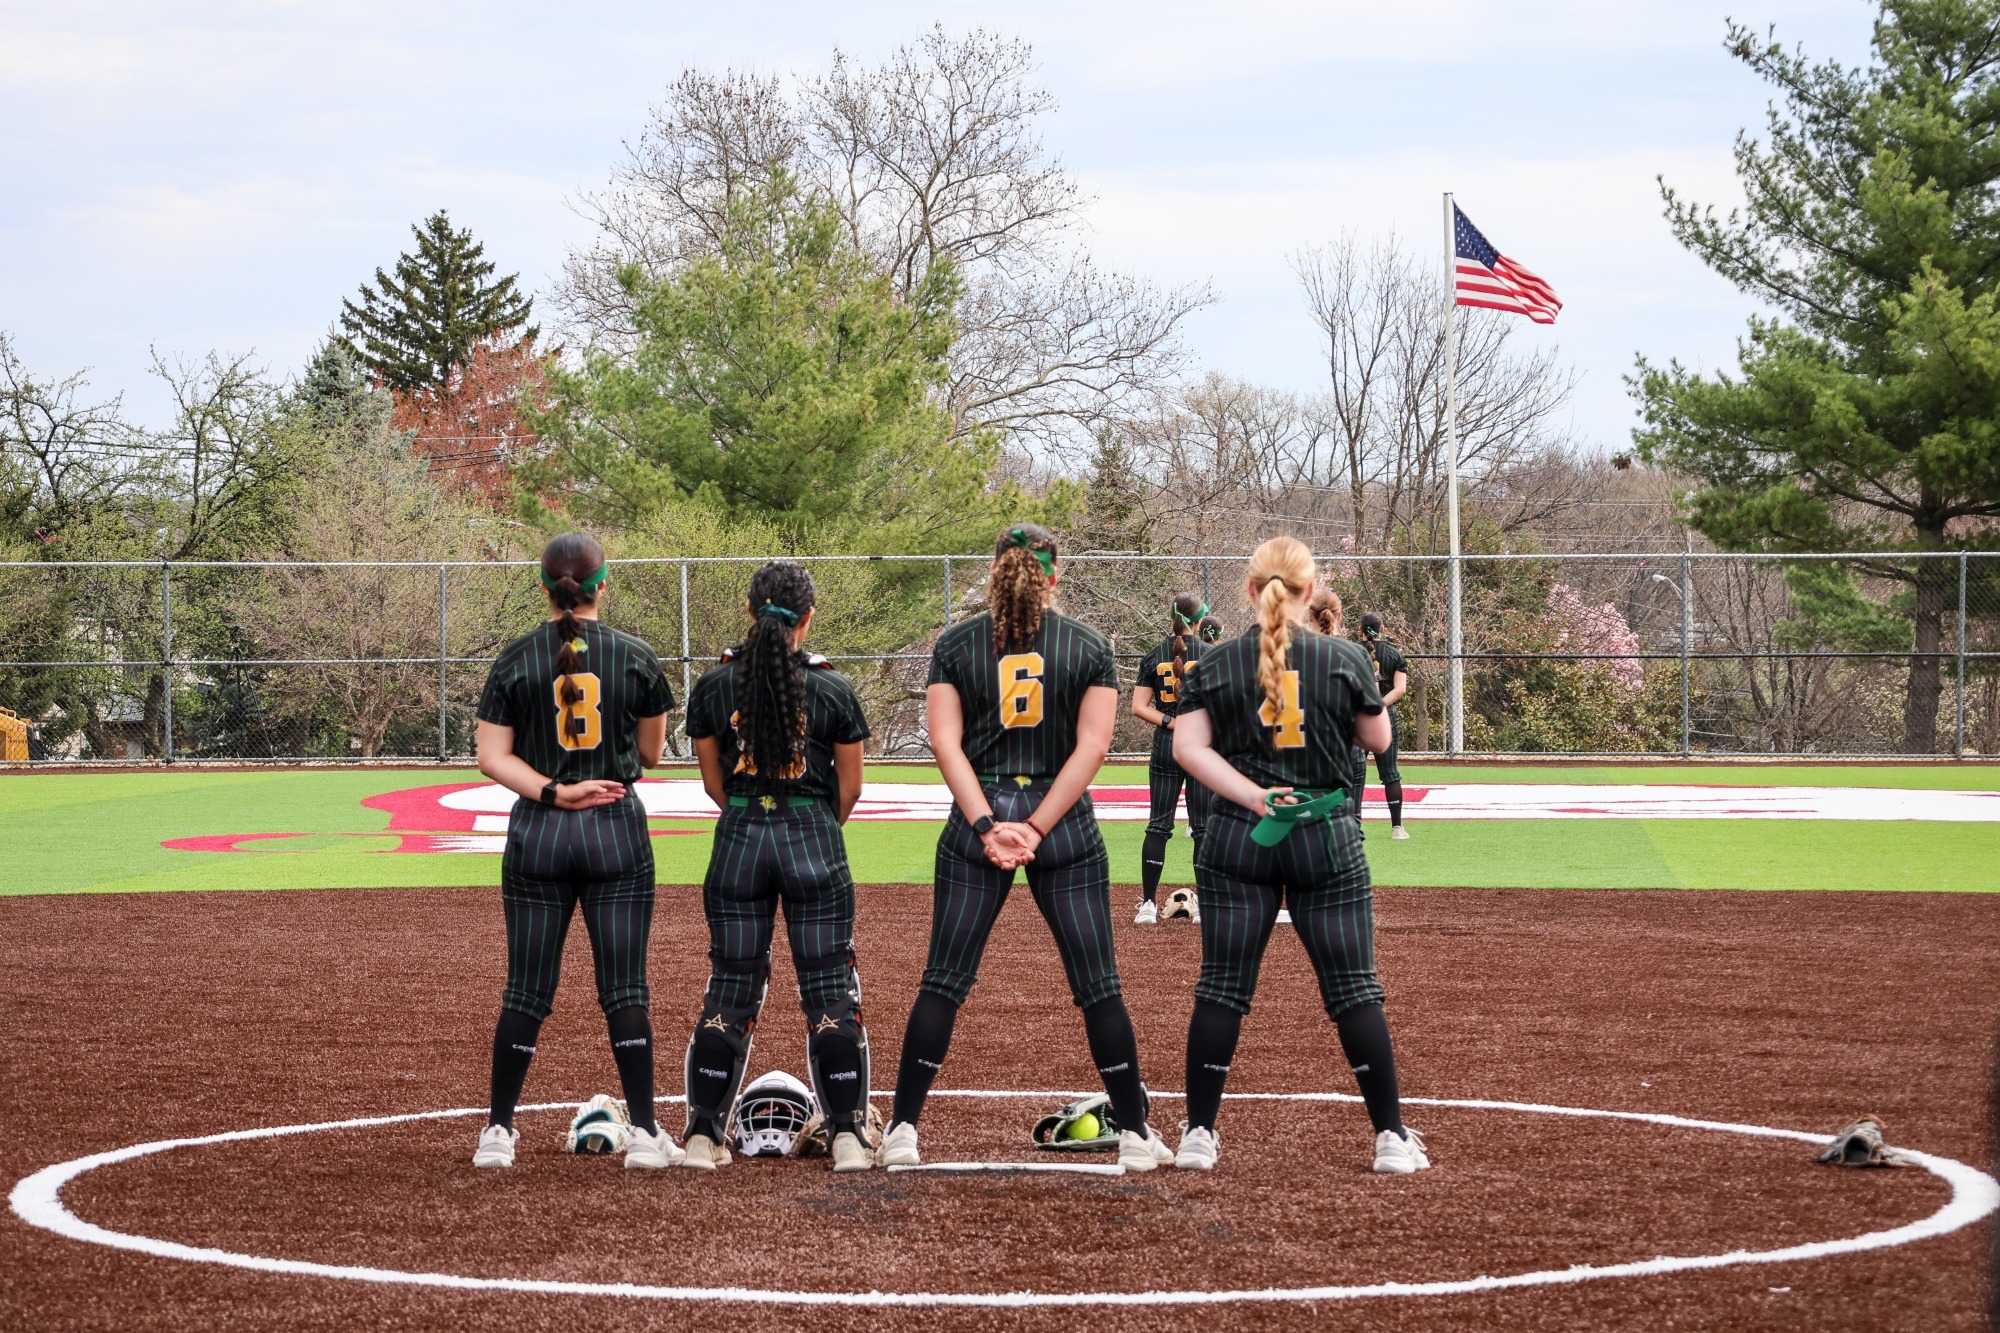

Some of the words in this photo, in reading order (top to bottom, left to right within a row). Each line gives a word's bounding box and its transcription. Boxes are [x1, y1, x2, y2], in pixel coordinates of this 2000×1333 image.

[553, 672, 602, 751] 8
[998, 652, 1044, 729] 6
[1258, 670, 1305, 747] 4
